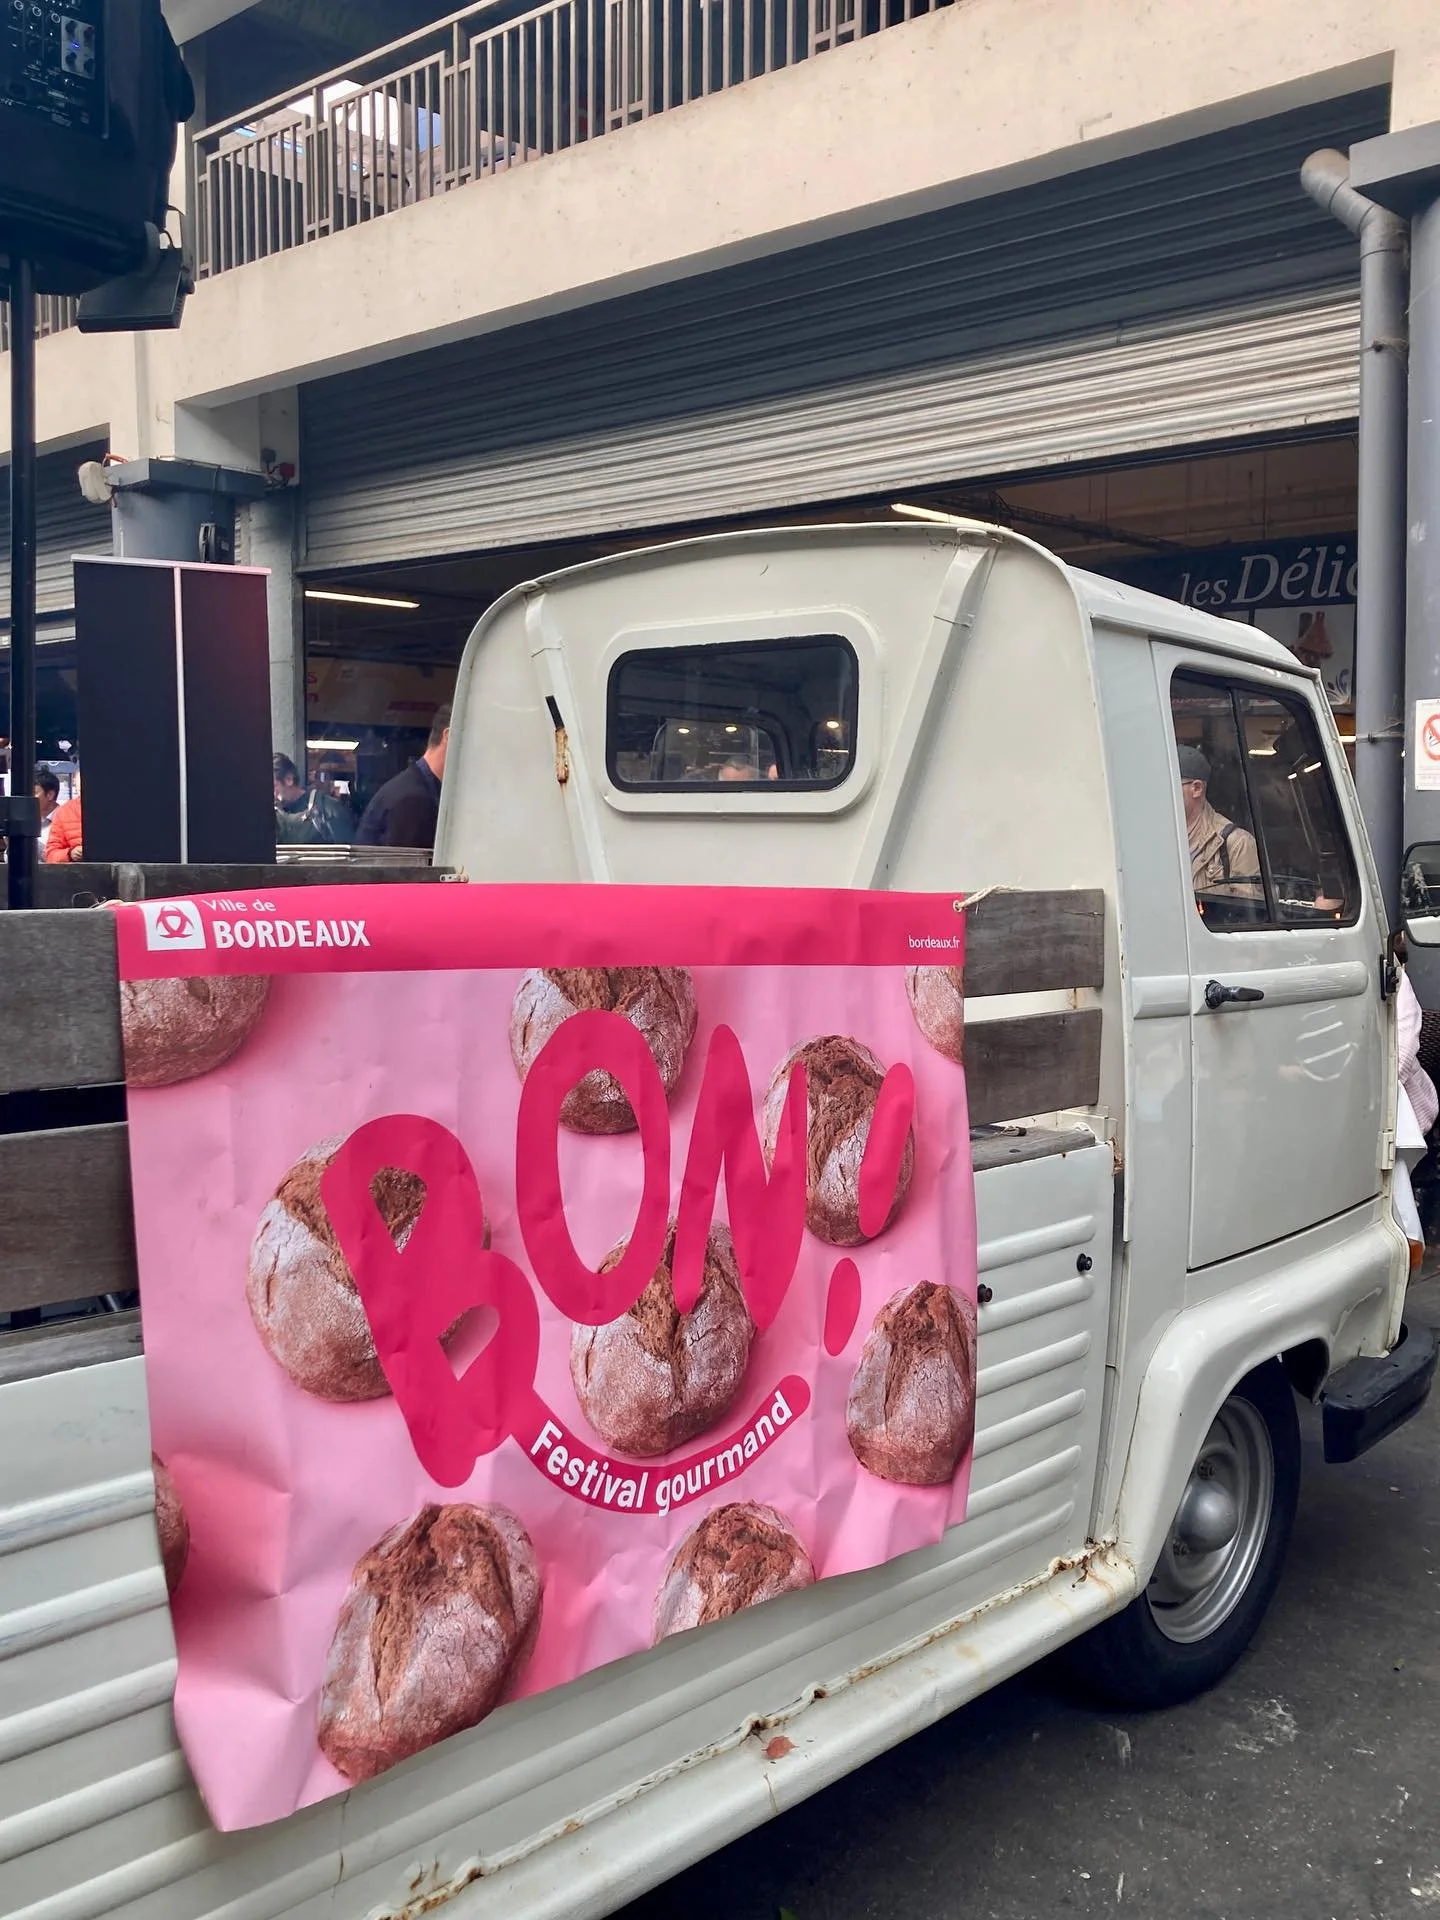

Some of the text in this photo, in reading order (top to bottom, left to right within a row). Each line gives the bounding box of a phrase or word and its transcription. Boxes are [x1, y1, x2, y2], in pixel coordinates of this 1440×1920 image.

[1180, 573, 1228, 605] les
[201, 898, 276, 912] Ville de
[213, 919, 371, 949] BORDEAUX
[908, 935, 960, 948] bordeaux.fr
[530, 1390, 793, 1517] Festival gourmand
